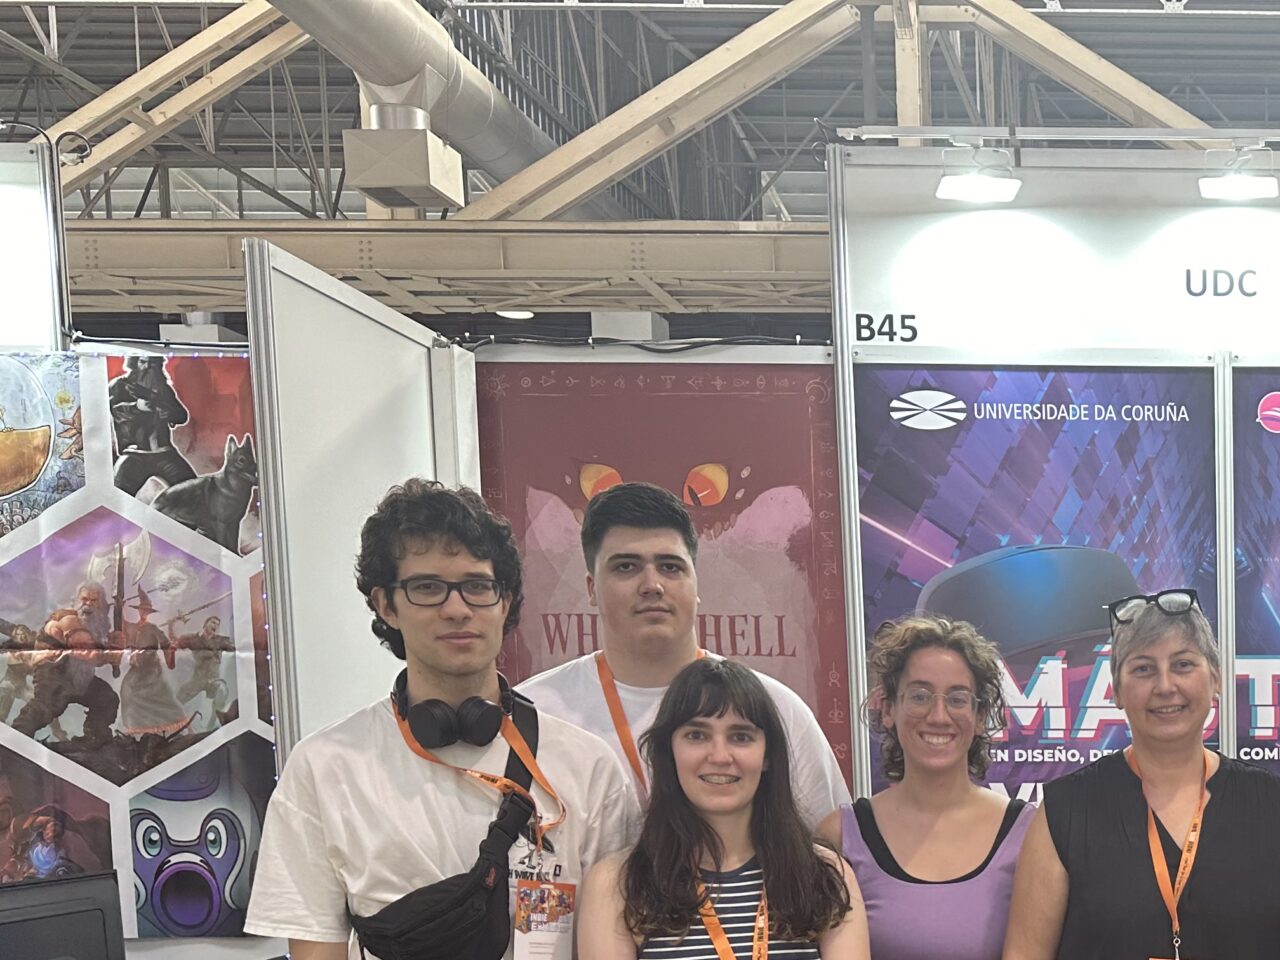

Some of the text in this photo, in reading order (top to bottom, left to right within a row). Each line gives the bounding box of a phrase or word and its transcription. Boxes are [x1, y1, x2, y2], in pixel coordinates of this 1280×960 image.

[1185, 269, 1258, 297] UDC
[855, 313, 918, 343] B45
[973, 401, 1190, 422] UNIVERSIDADE DA CORUÑA
[1014, 746, 1085, 764] DISEÑO,
